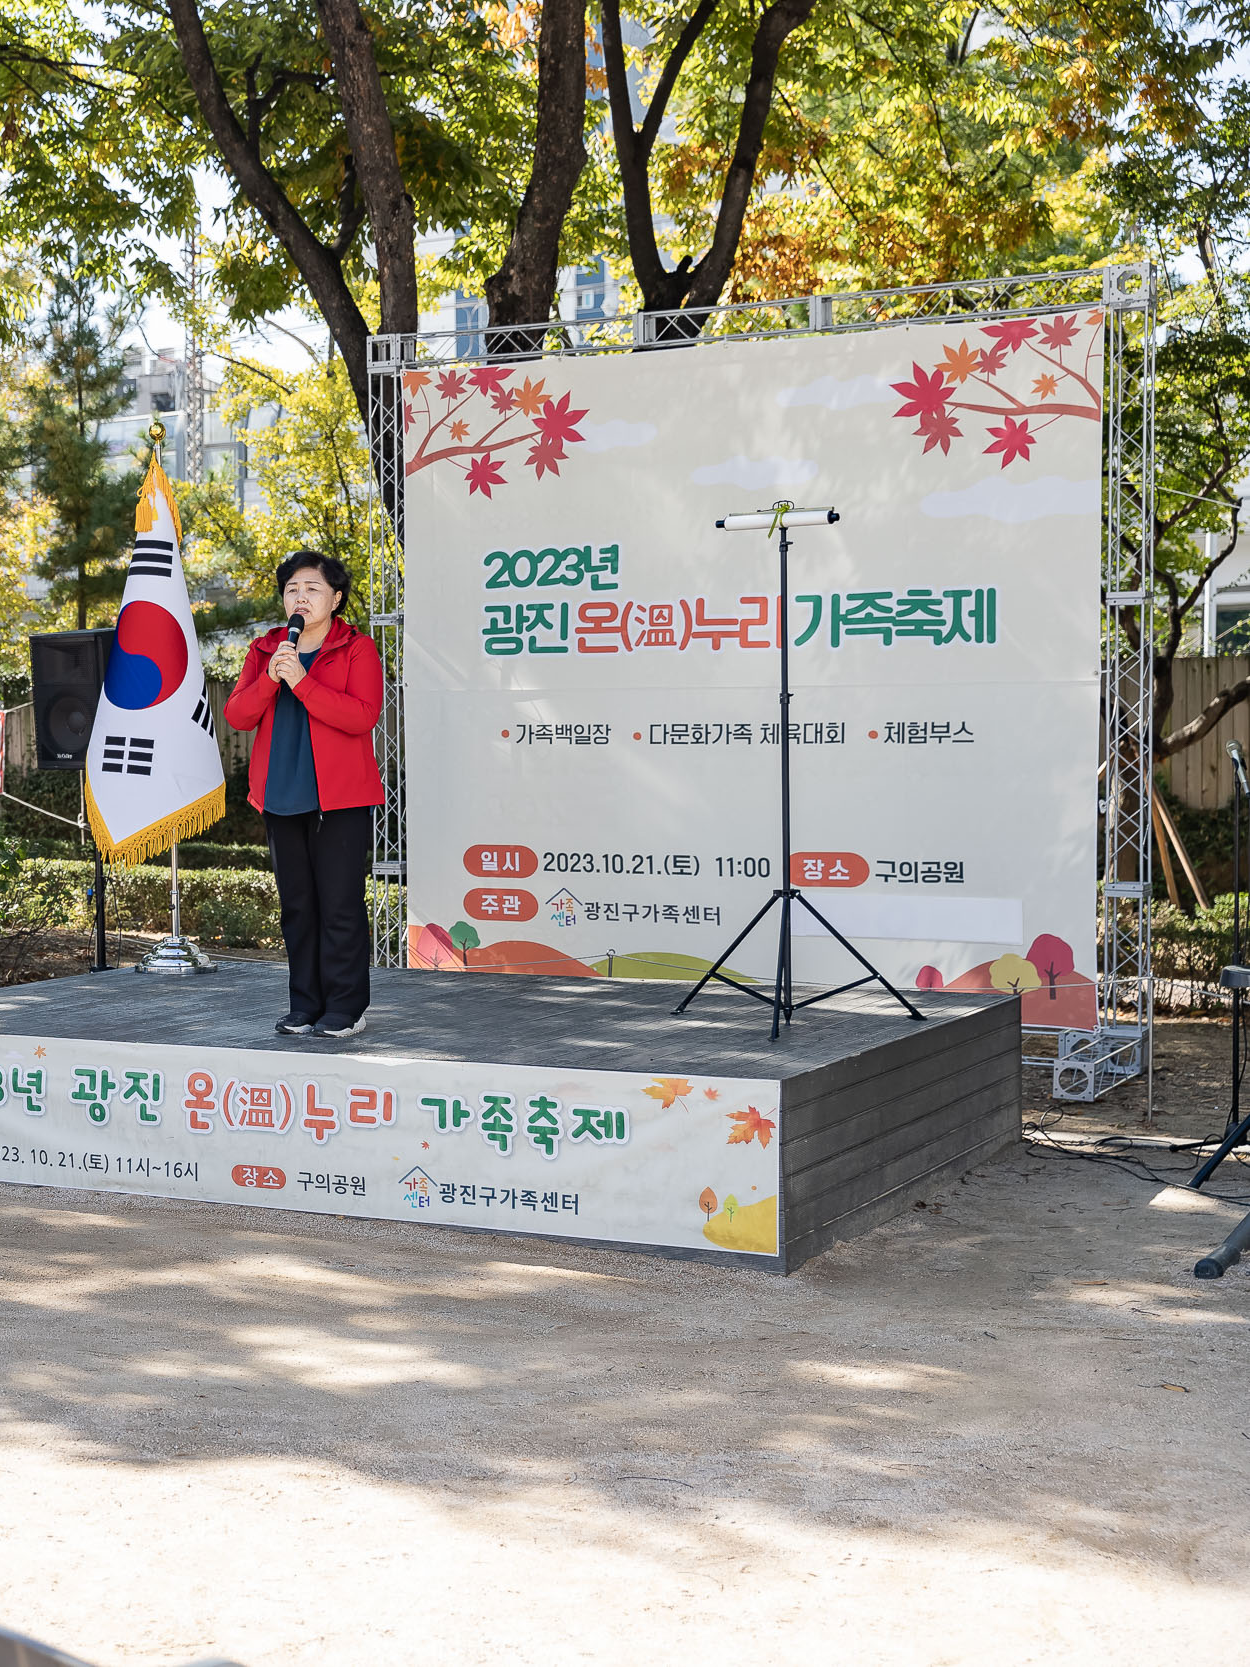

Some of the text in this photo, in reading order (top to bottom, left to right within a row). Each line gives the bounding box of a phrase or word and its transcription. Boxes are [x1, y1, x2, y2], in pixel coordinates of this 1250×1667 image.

[483, 543, 619, 591] 2023년
[481, 601, 569, 656] 광진
[793, 587, 997, 648] 가족축제
[515, 721, 975, 745] 가족백일장 다문화가족 체육대회 체험부스
[480, 850, 521, 873] 일시
[543, 852, 771, 878] 2023.10.21.(토) 11:00
[874, 859, 965, 884] 구의공원
[480, 893, 522, 916] 주관
[583, 901, 722, 927] 광진구가족센터
[70, 1067, 161, 1123] 광진
[183, 1071, 394, 1142] 온(溫)누리
[419, 1094, 626, 1157] 가족축제
[30, 1148, 53, 1168] 10.
[115, 1156, 199, 1182] 11시~16시
[296, 1170, 368, 1197] 구의공원
[438, 1182, 581, 1216] 광진구가족센터
